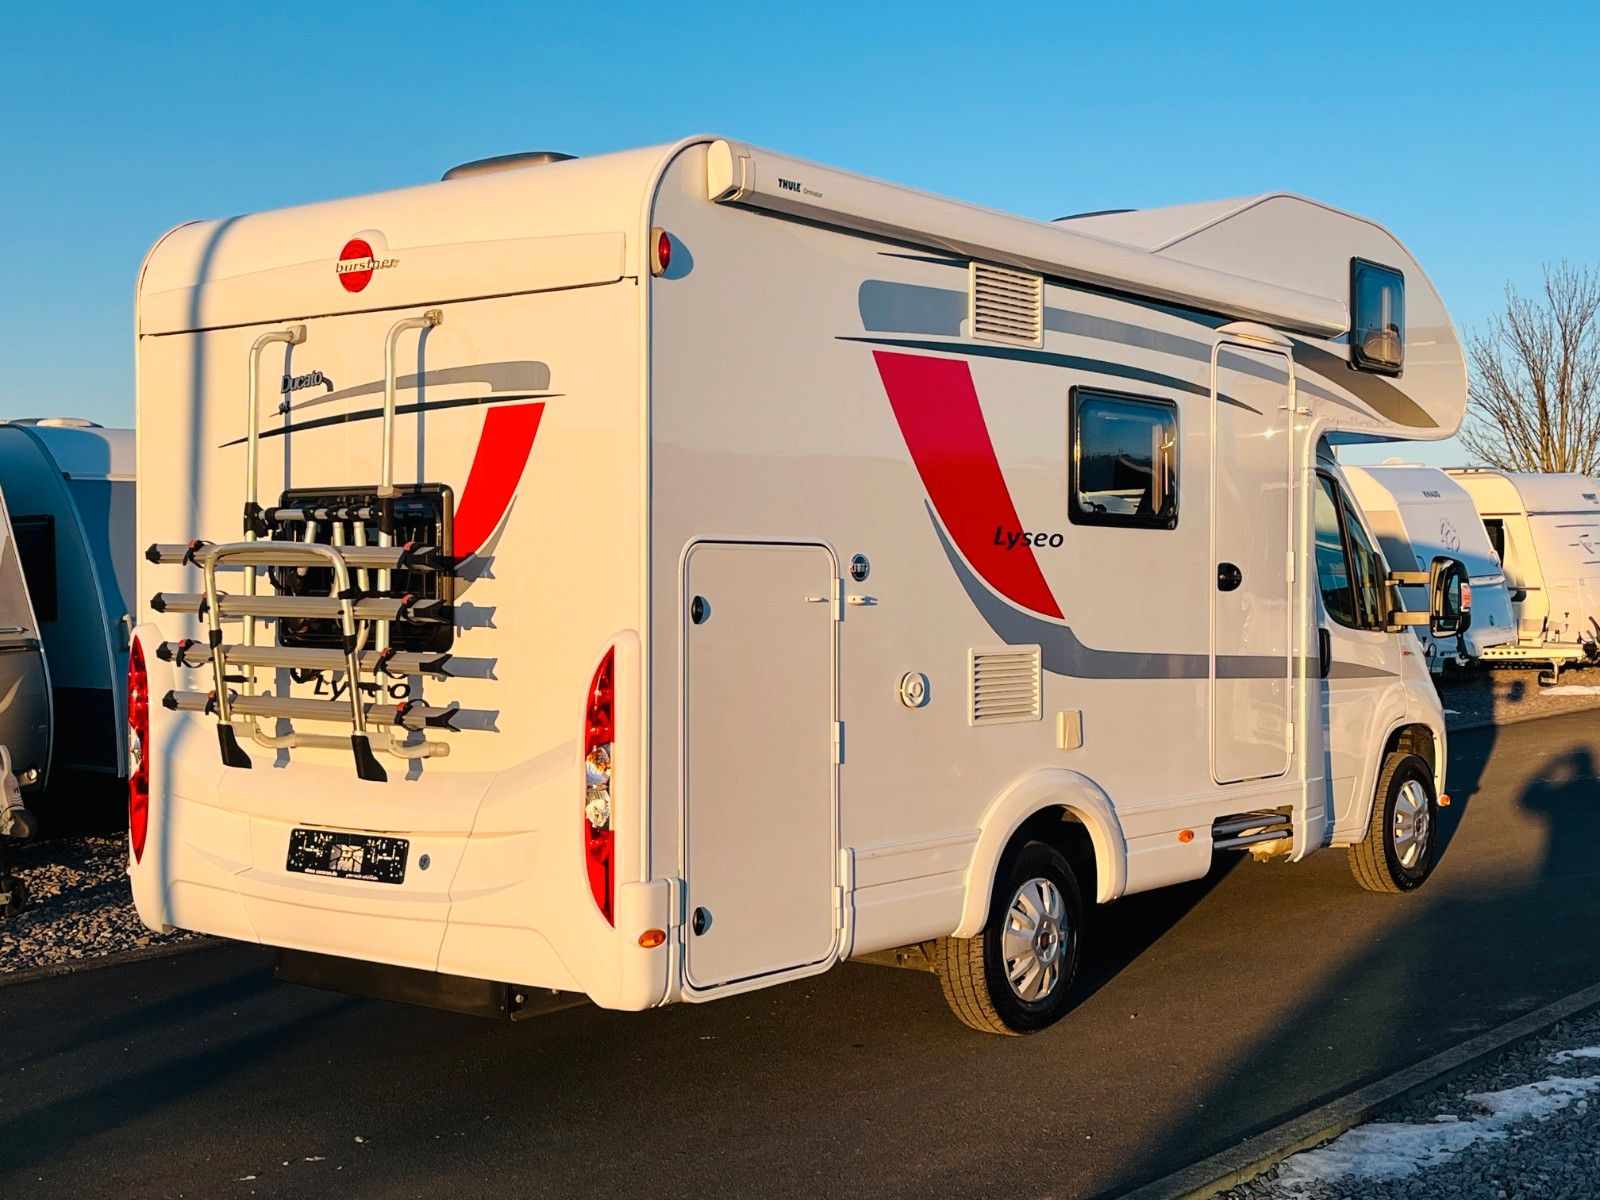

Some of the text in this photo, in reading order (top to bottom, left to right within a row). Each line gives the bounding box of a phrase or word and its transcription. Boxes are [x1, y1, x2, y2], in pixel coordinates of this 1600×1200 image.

[778, 178, 801, 193] THULE
[280, 370, 324, 394] Ducato
[993, 526, 1064, 551] Lyseo
[314, 672, 411, 702] Lyo
